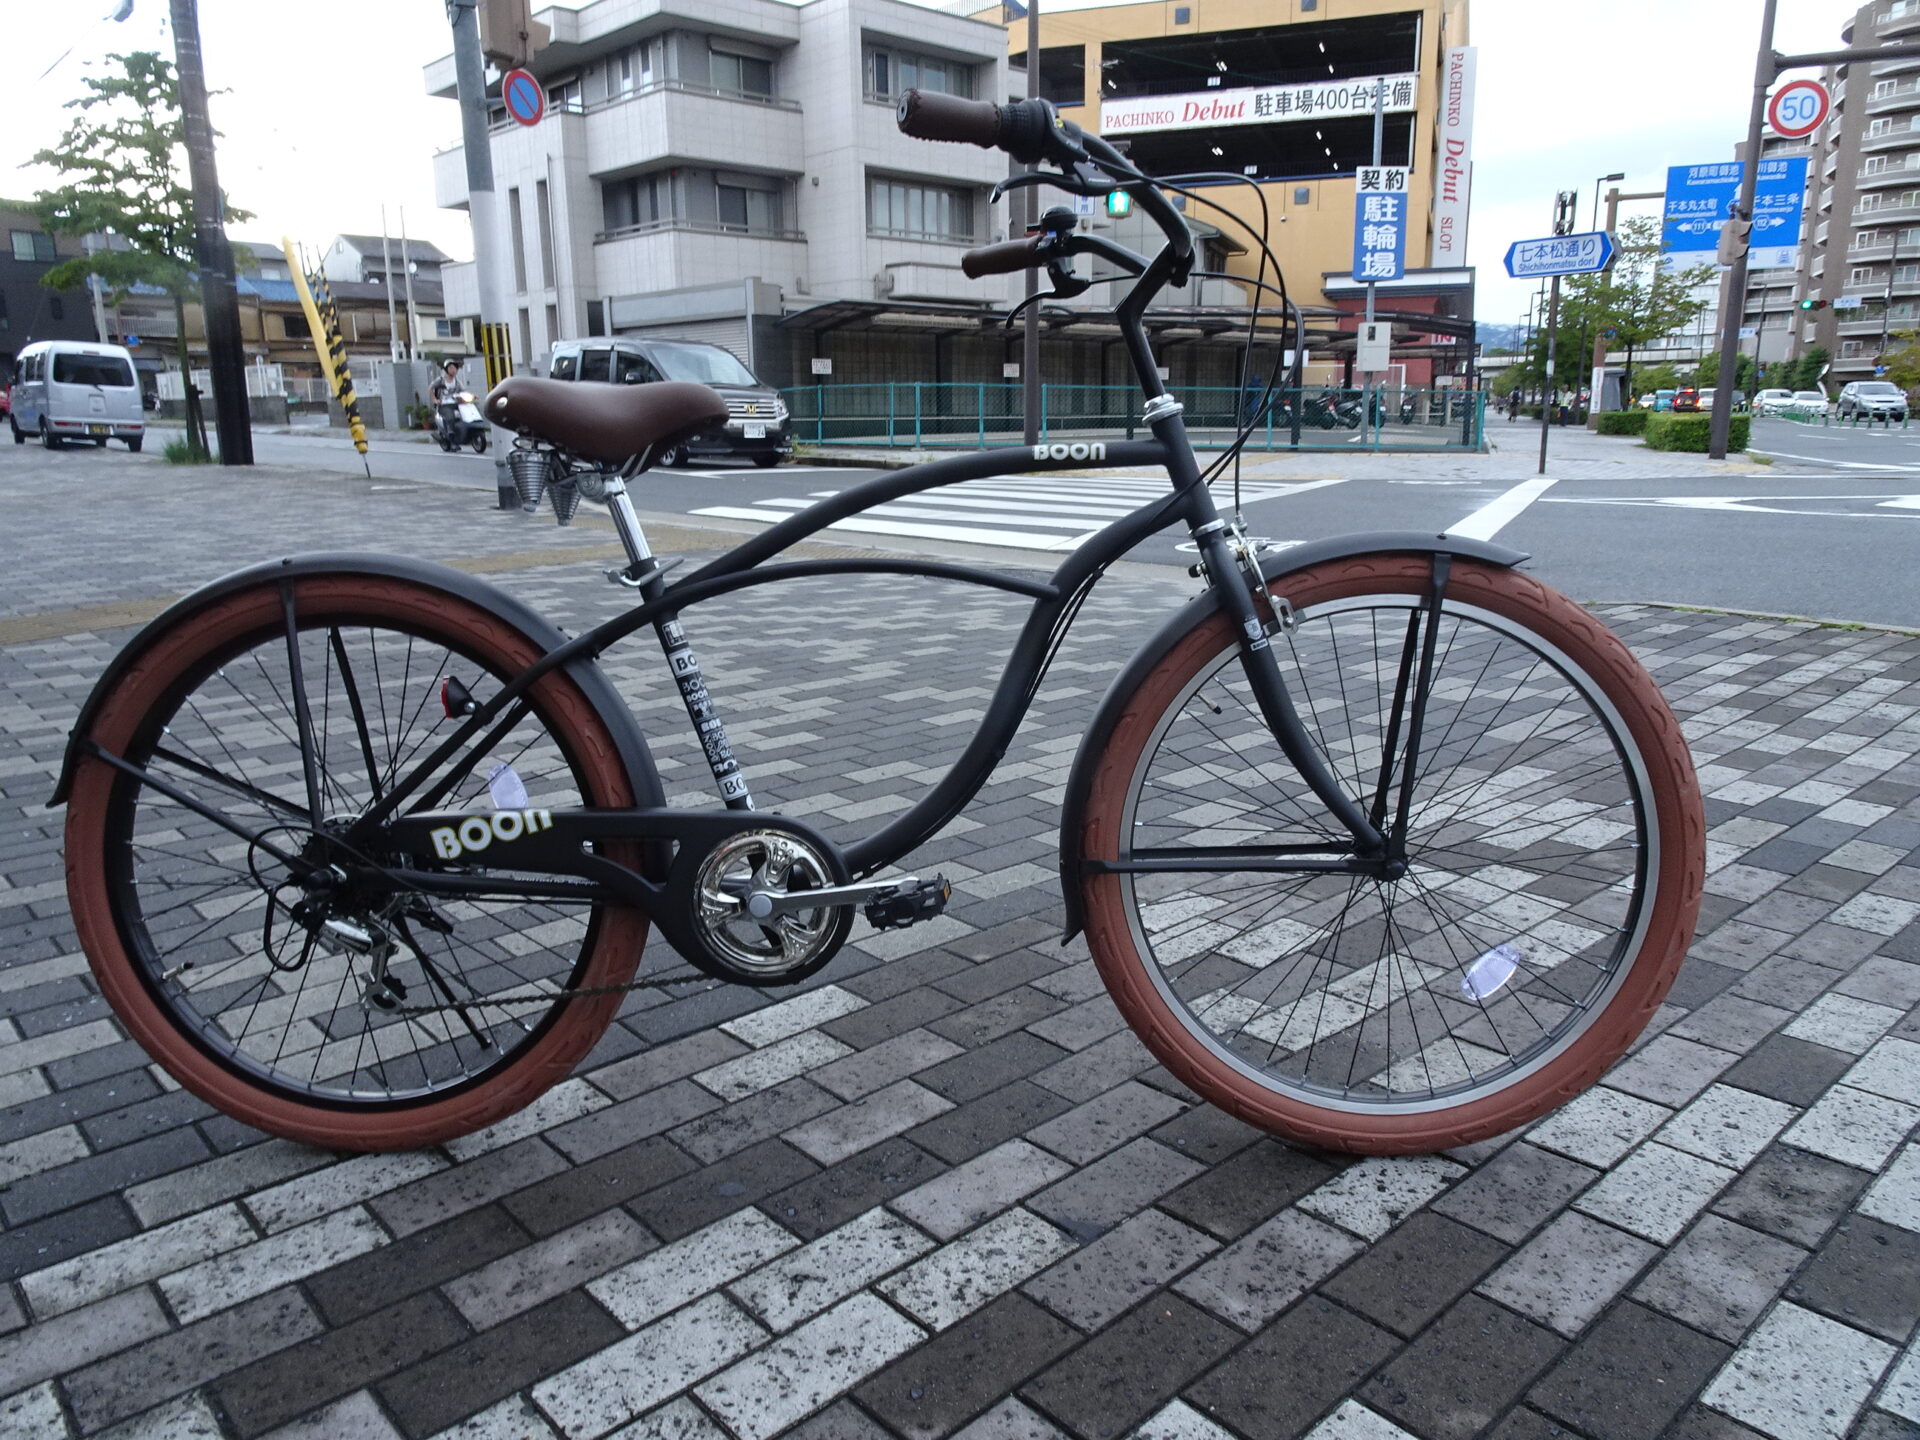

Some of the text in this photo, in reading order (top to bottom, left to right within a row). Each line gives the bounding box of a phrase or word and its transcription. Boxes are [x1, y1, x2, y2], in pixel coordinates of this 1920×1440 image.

[1105, 80, 1412, 128] PACHINKO Debut 駐車場400台完備
[1782, 95, 1816, 121] 50
[1439, 53, 1465, 251] PACHINKO Debut SLOT
[1361, 169, 1404, 190] 契約
[1361, 196, 1399, 278] 駐輪場
[1519, 238, 1596, 263] 七本松通り
[1518, 257, 1595, 273] Shichihonmatsu dori
[1033, 442, 1106, 460] BOON
[430, 809, 553, 860] BOON
